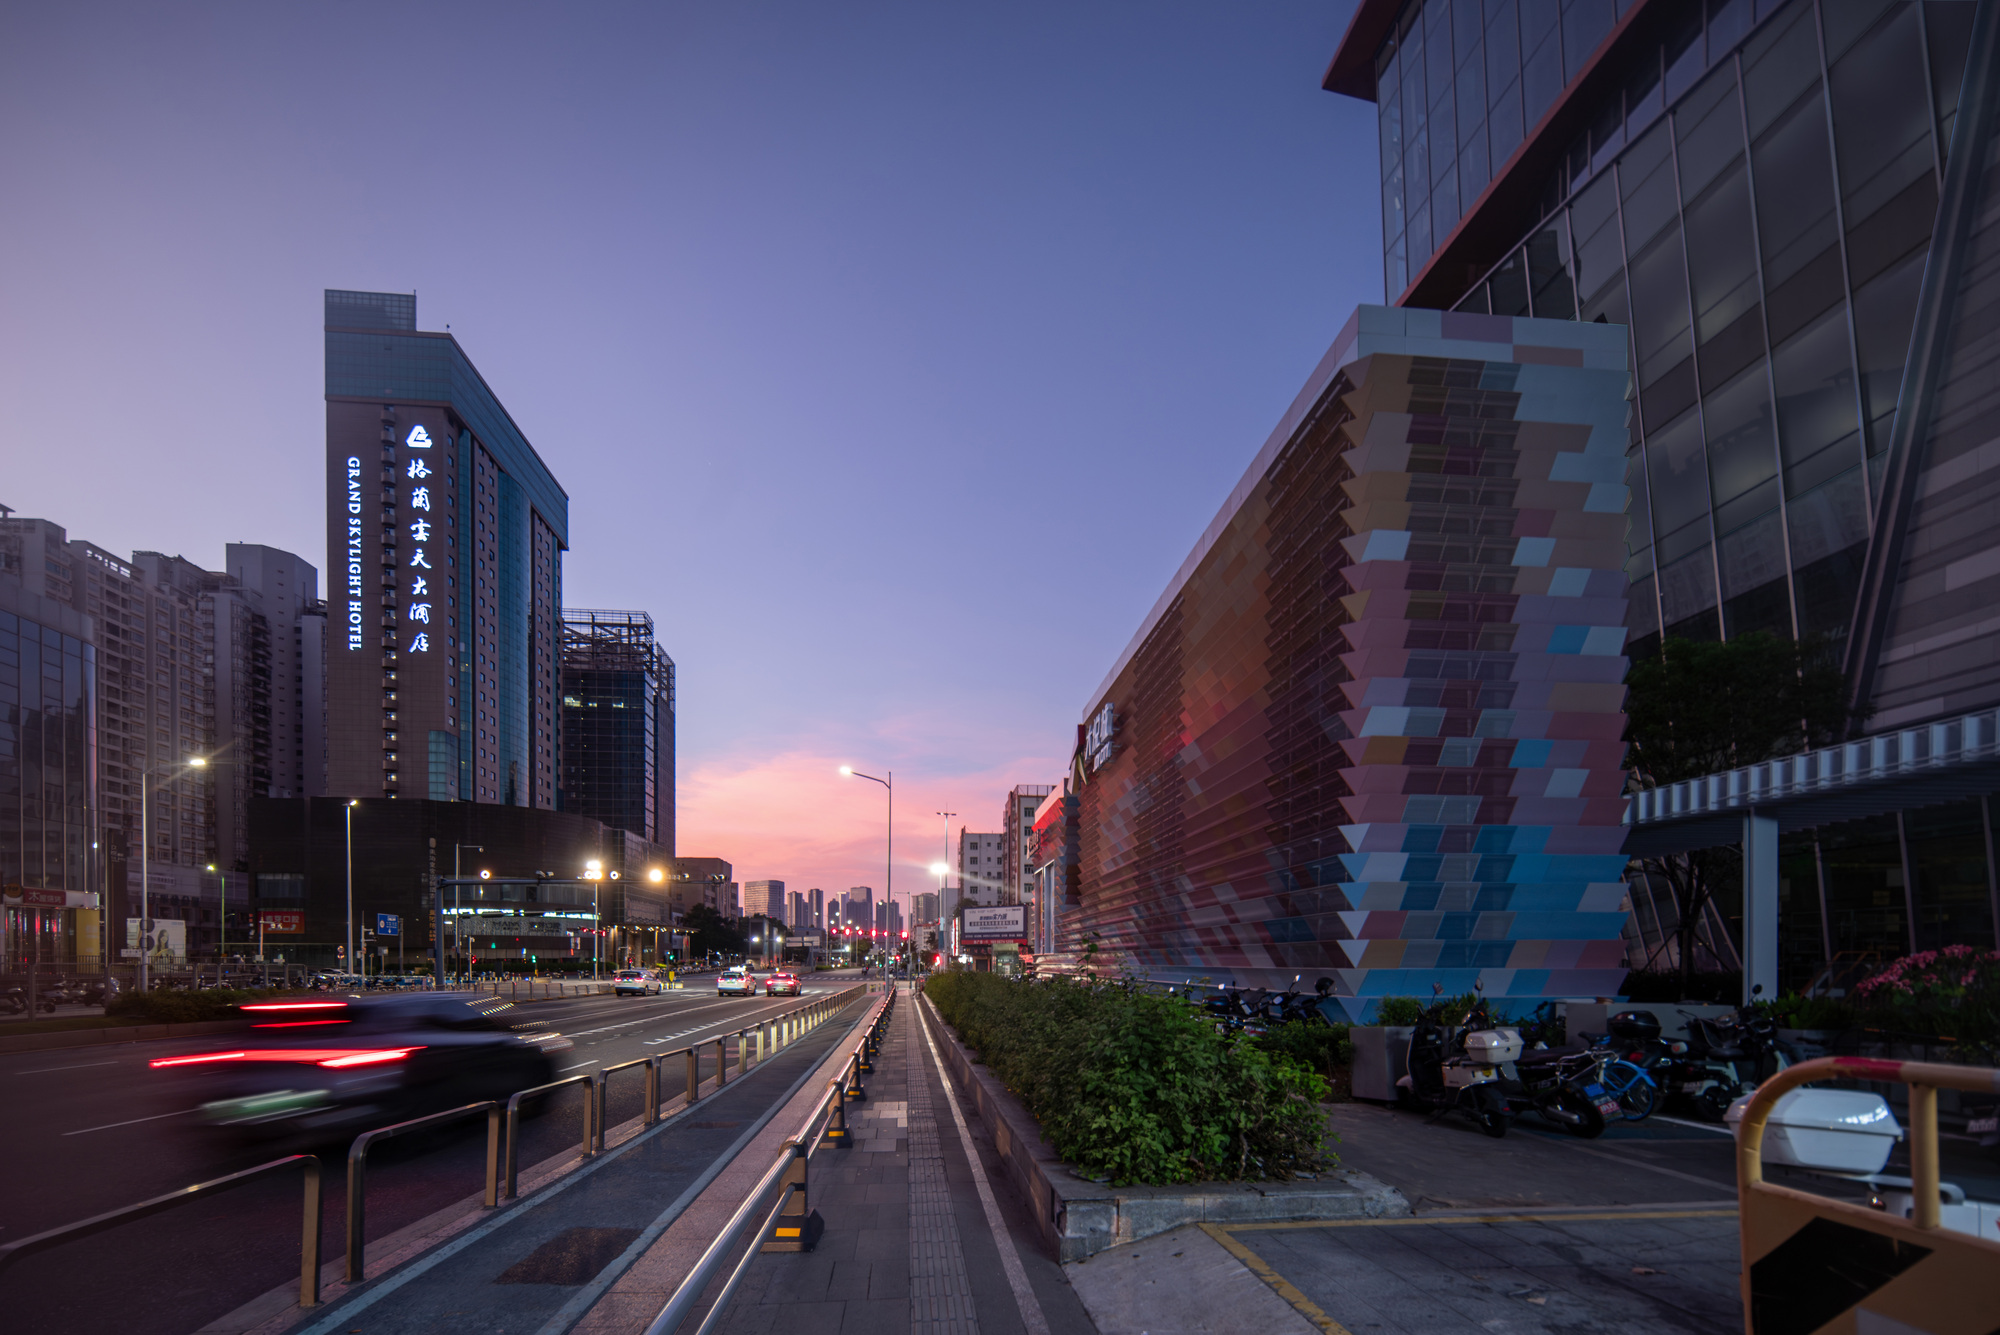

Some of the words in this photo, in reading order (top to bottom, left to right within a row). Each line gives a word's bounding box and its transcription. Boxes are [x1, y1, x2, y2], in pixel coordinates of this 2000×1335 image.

[347, 456, 361, 514] GRAND
[348, 517, 362, 597] SKYLIGHT
[348, 600, 362, 651] HOTEL
